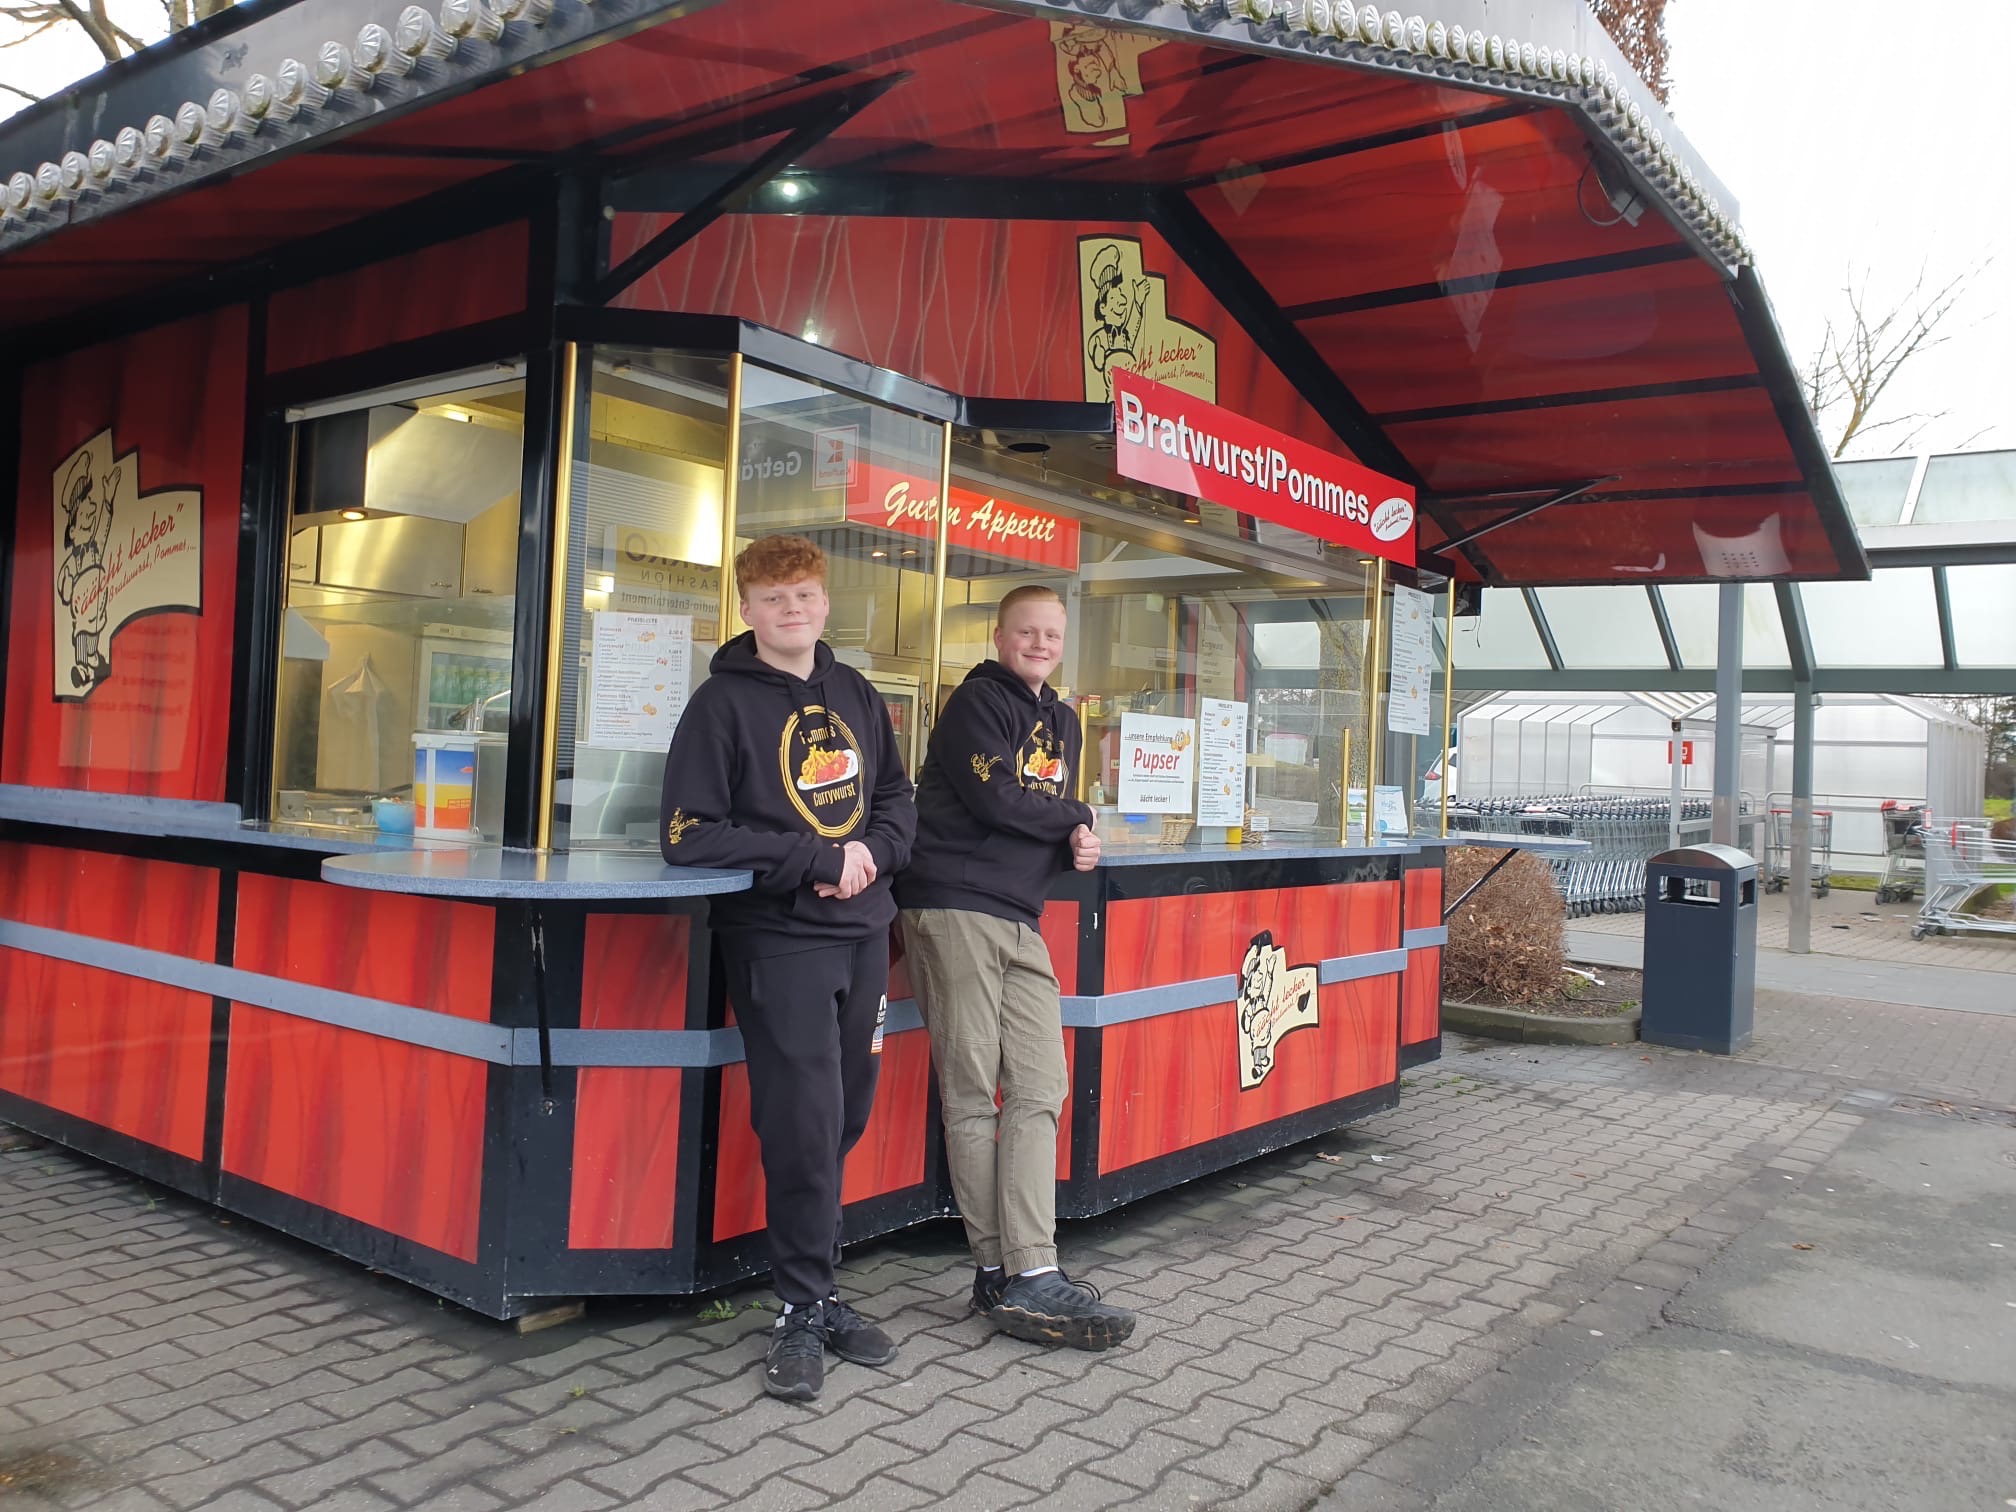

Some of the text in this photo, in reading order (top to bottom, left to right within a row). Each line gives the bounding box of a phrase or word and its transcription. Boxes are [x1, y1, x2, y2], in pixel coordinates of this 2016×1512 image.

[1119, 390, 1370, 526] Bratwurst/Pommes
[884, 481, 1056, 543] Gutn Appetit
[798, 725, 836, 745] Pmms
[1133, 747, 1180, 775] Pupser
[813, 781, 857, 807] Currywurst
